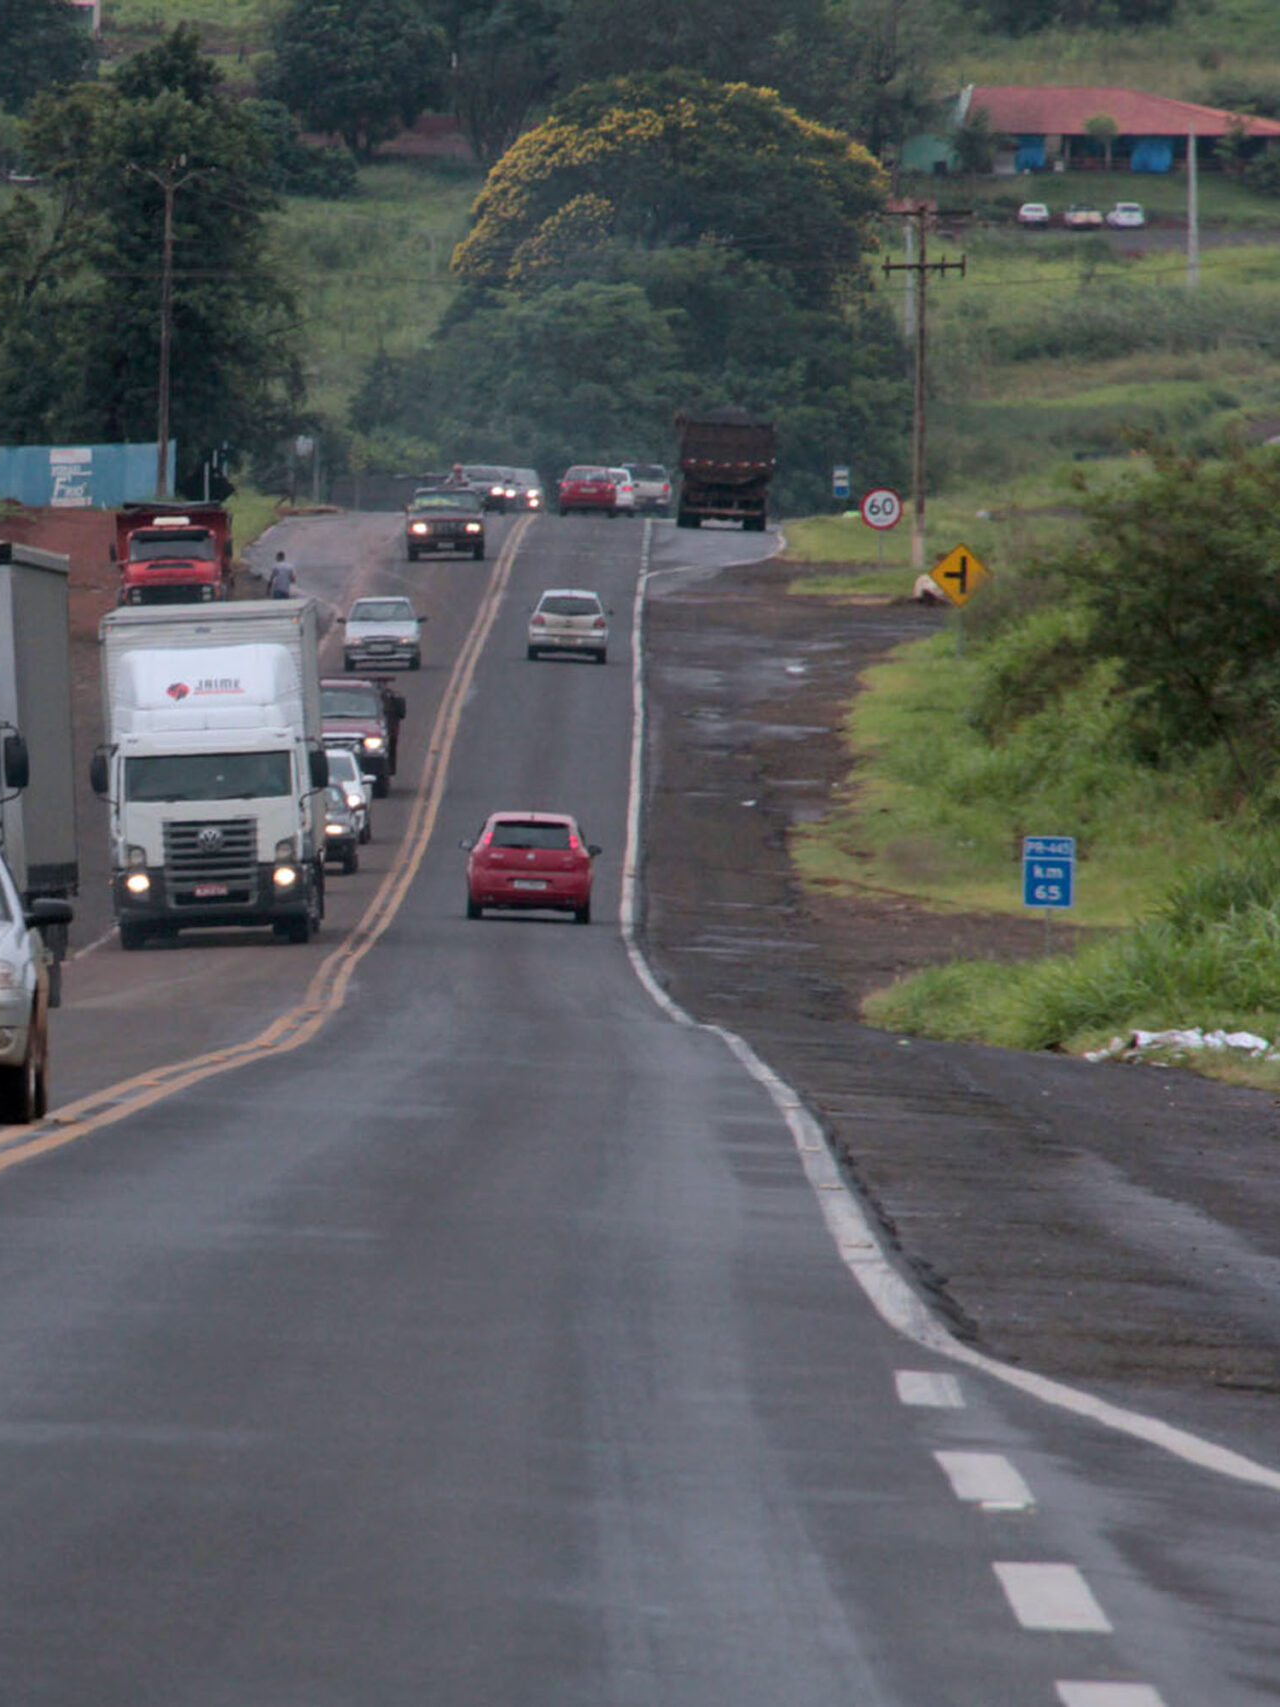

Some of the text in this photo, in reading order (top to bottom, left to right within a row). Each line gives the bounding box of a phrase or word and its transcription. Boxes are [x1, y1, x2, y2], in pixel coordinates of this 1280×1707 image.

[868, 497, 895, 516] 60
[195, 678, 241, 691] JAIME
[1033, 864, 1064, 879] km
[1035, 885, 1061, 900] 65
